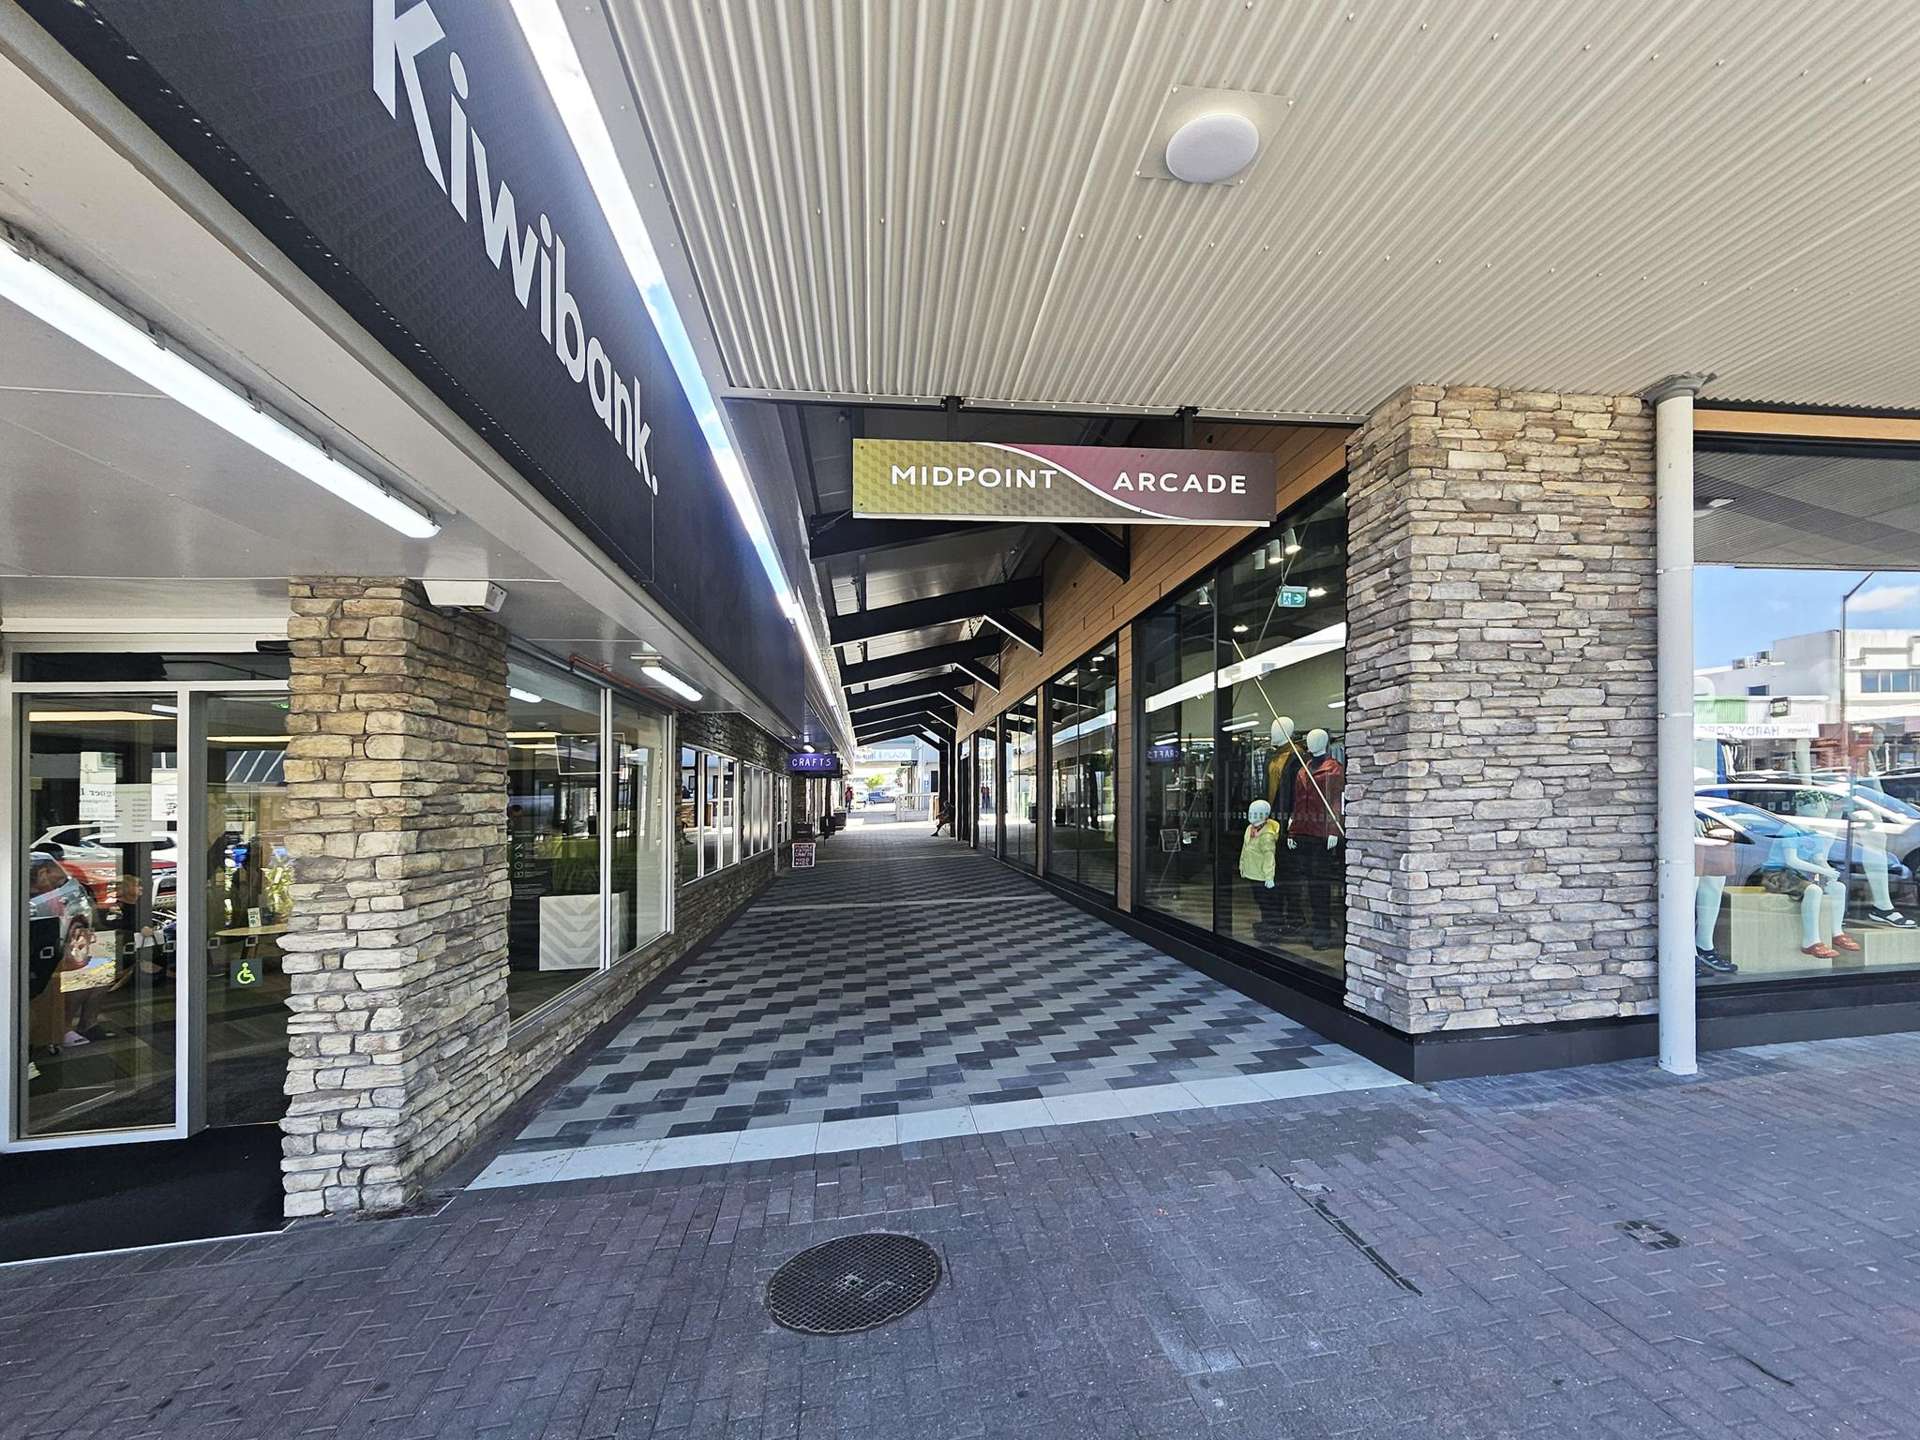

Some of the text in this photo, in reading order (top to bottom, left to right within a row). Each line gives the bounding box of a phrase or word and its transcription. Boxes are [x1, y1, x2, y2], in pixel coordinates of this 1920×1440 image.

[891, 465, 1247, 495] MIDPOINT ARCADE
[792, 759, 832, 767] CRAFTS
